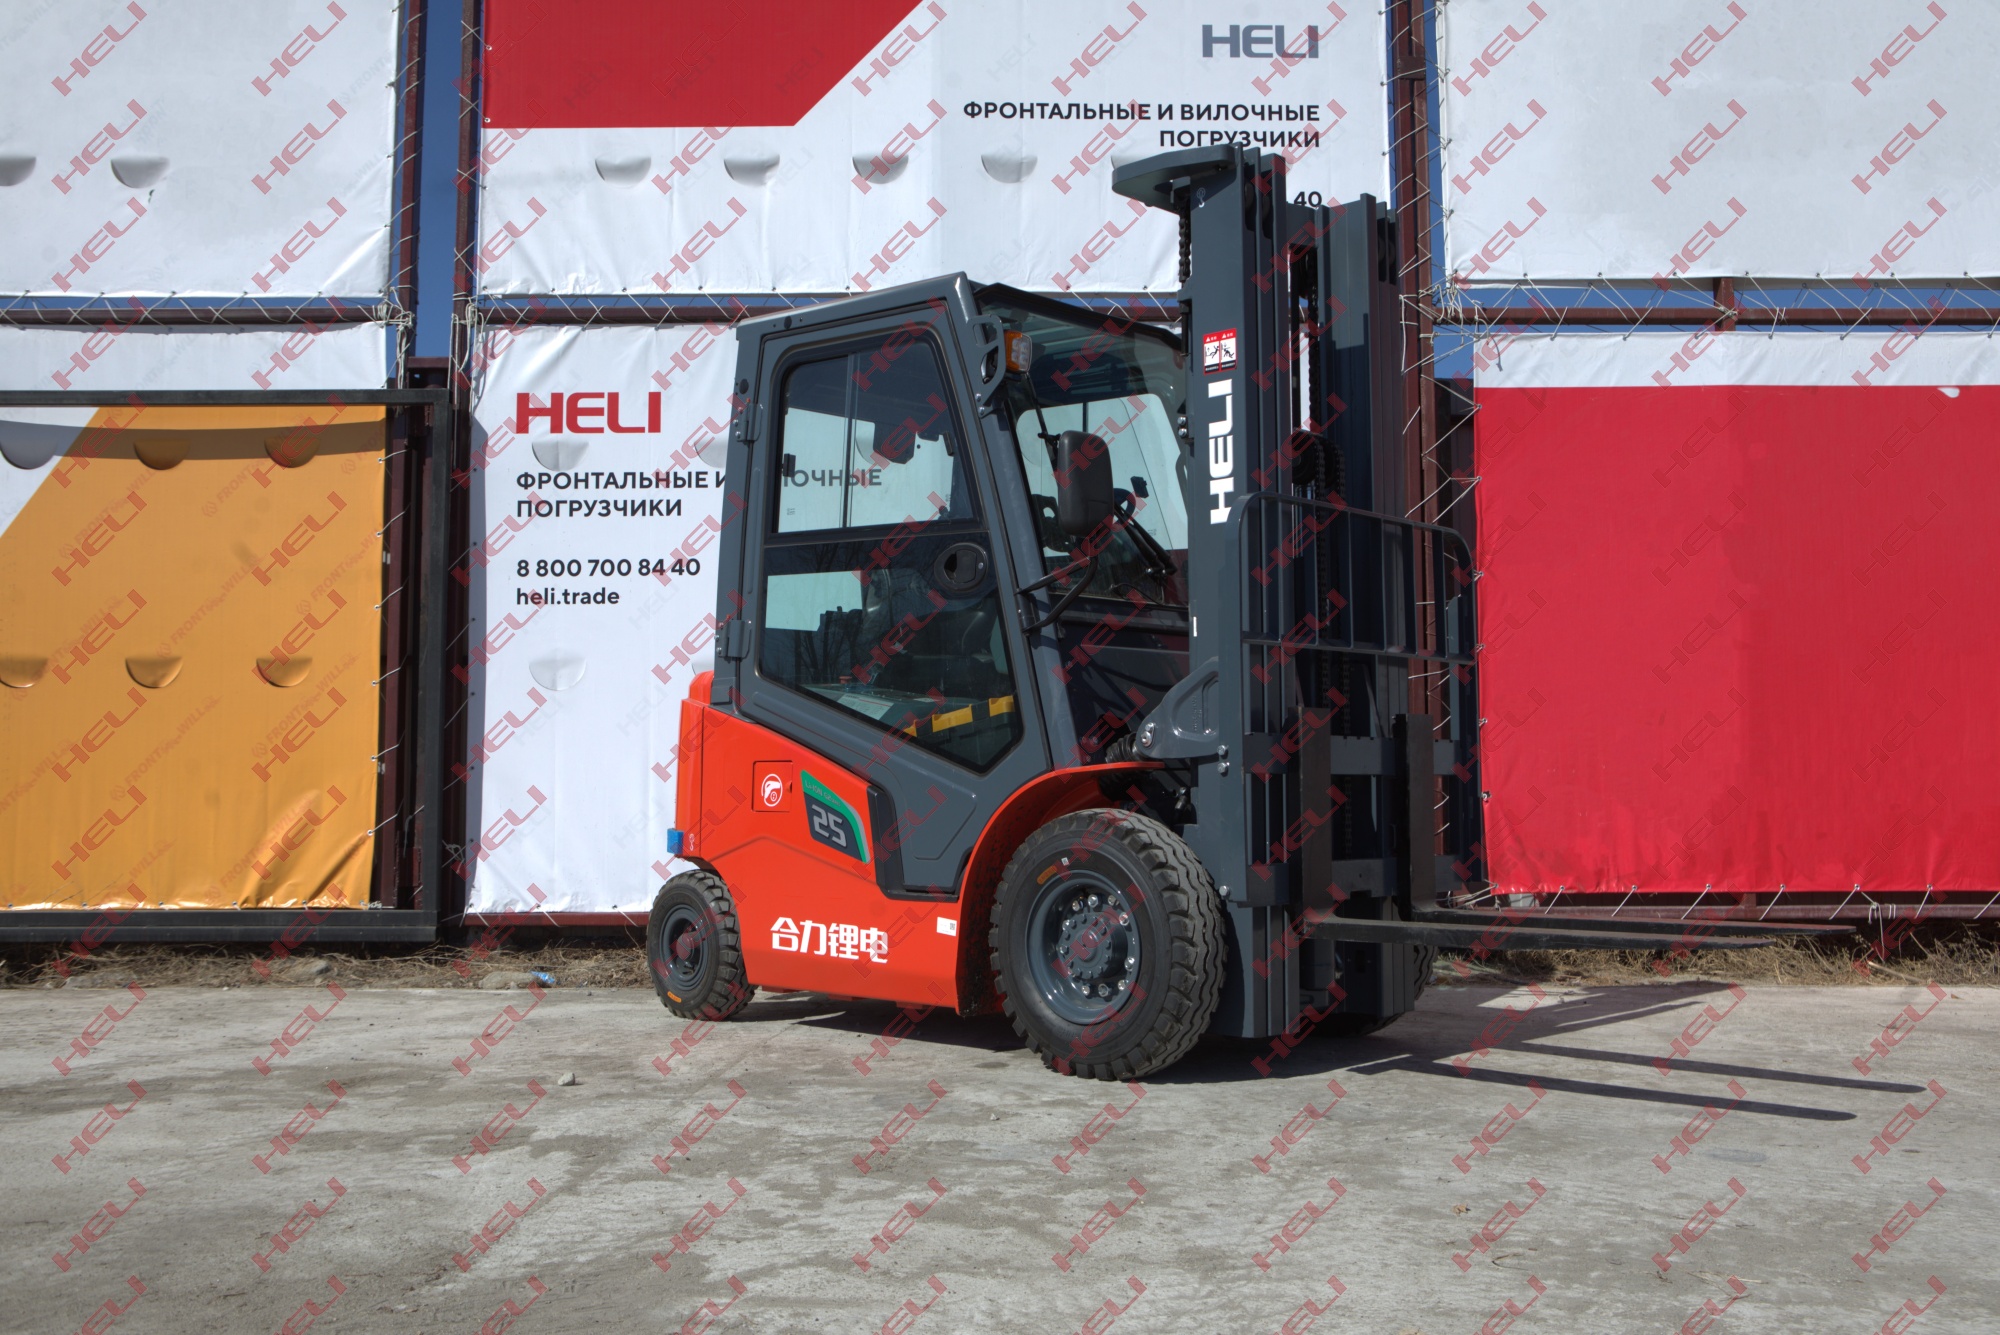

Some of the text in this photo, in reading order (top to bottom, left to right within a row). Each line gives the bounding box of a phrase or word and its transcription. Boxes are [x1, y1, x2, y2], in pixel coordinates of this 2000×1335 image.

[1202, 24, 1319, 59] HELI
[963, 101, 1320, 121] ФРОНТАЛЬНЫЕ И ВИЛОЧНЫЕ
[1160, 130, 1320, 148] ПОГРУЗЧИКИ
[1293, 191, 1322, 207] 40
[516, 391, 661, 434] HELI
[1208, 379, 1234, 524] HELI
[516, 470, 708, 491] ФРОНТАЛЬНЫЕ
[516, 498, 682, 517] ПОГРУЗЧИКИ
[516, 558, 701, 577] 8 800 700 84 40
[516, 587, 620, 605] heli.trade
[811, 804, 847, 848] 25
[770, 916, 888, 964] 合力锂电
